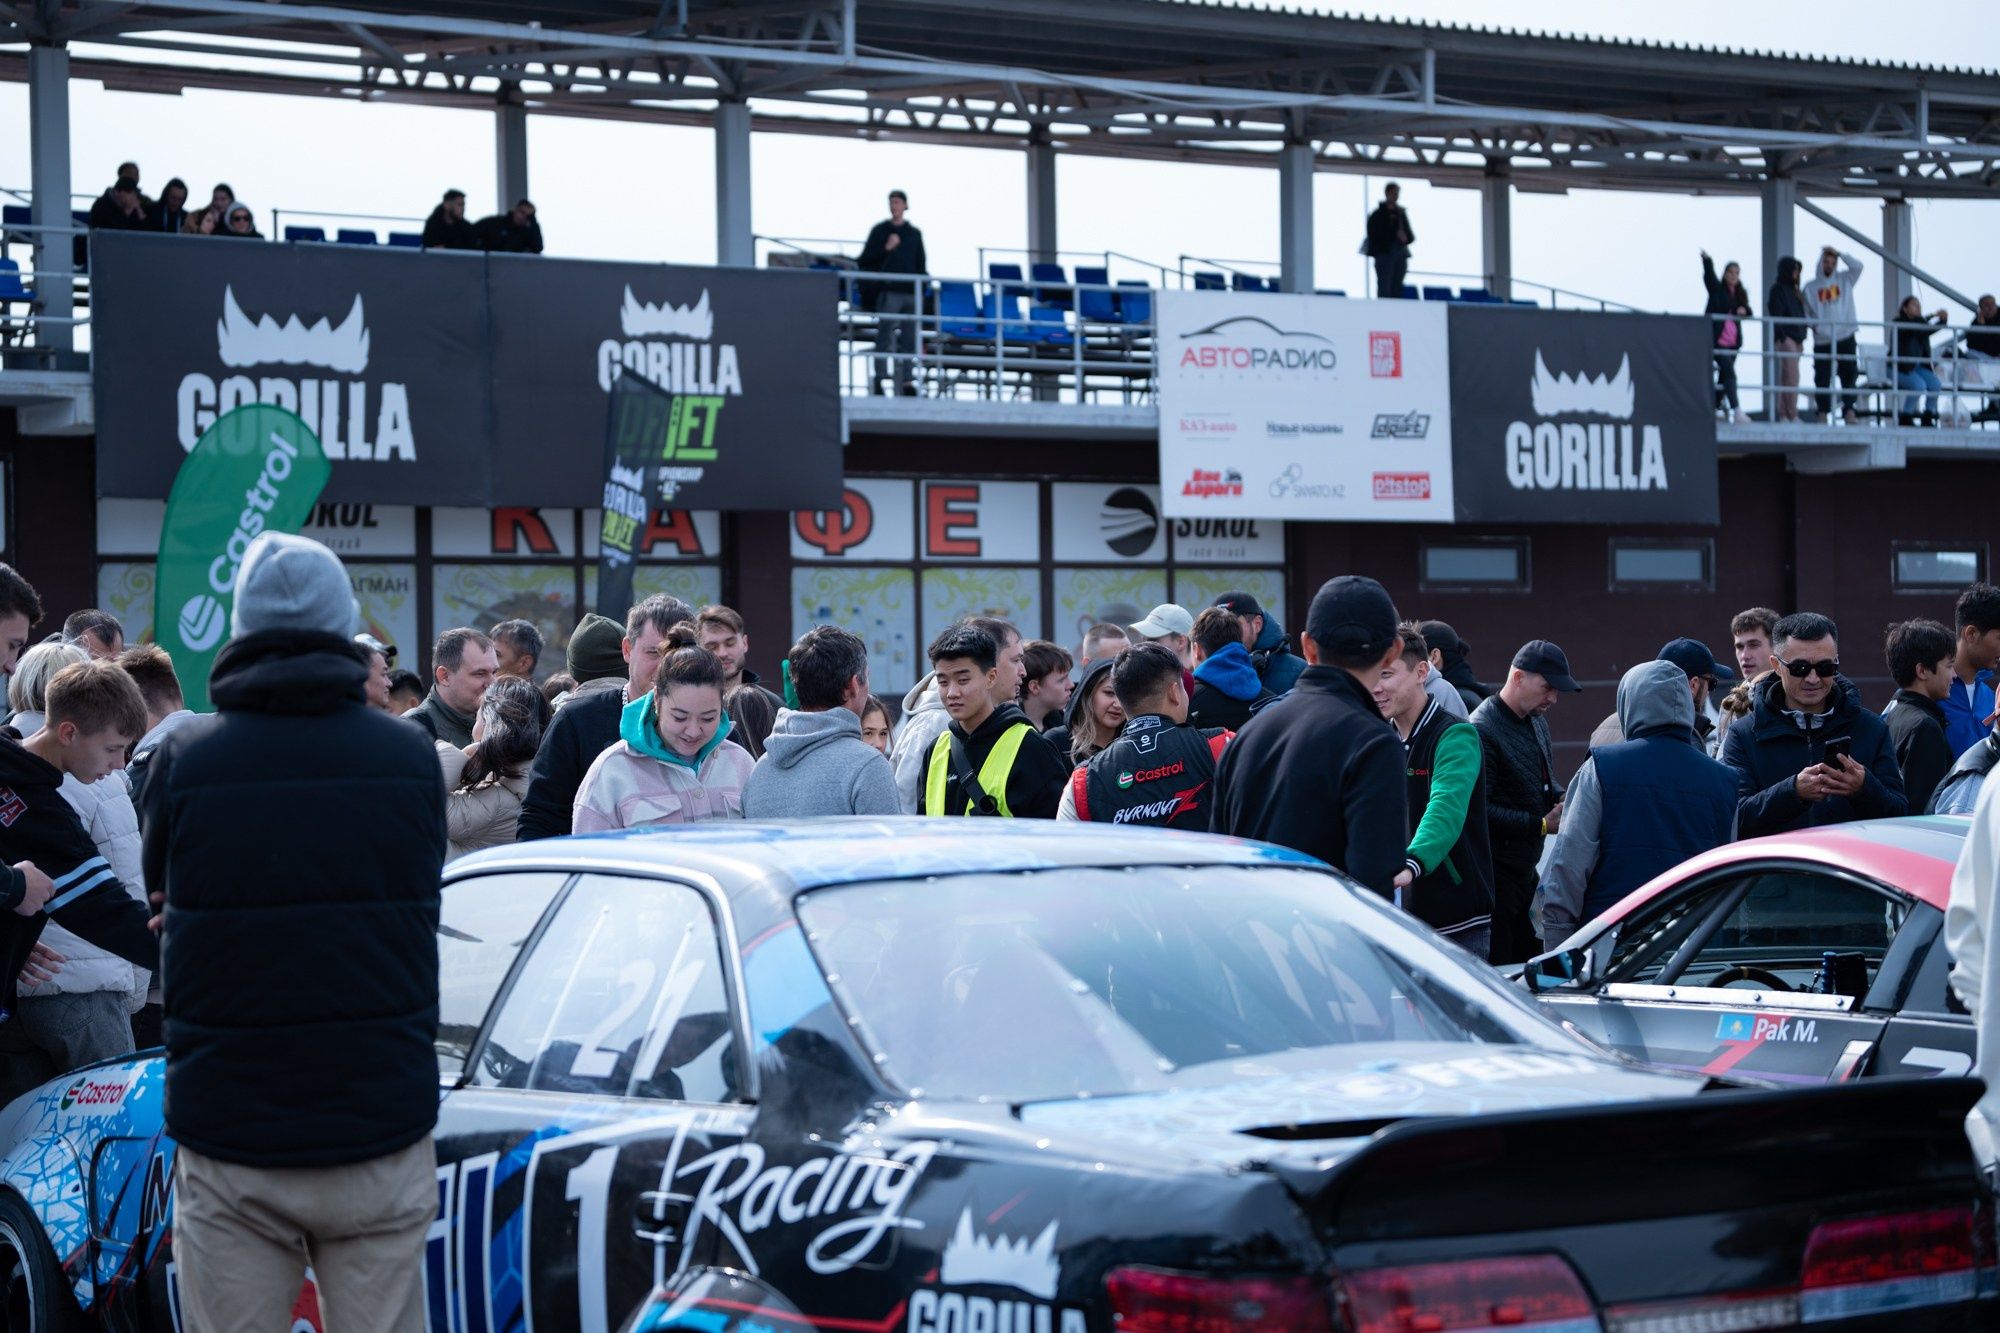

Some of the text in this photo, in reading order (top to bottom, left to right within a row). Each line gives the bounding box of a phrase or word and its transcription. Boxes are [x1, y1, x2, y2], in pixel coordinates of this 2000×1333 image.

[1505, 420, 1668, 491] GORILLA
[208, 431, 299, 594] Castrol
[1135, 759, 1184, 783] Castrol
[1112, 796, 1183, 827] BURNOUT
[569, 958, 707, 1083] 21
[1754, 1018, 1818, 1043] Pak M.
[78, 1080, 130, 1105] Castrol
[676, 1140, 941, 1275] Racing
